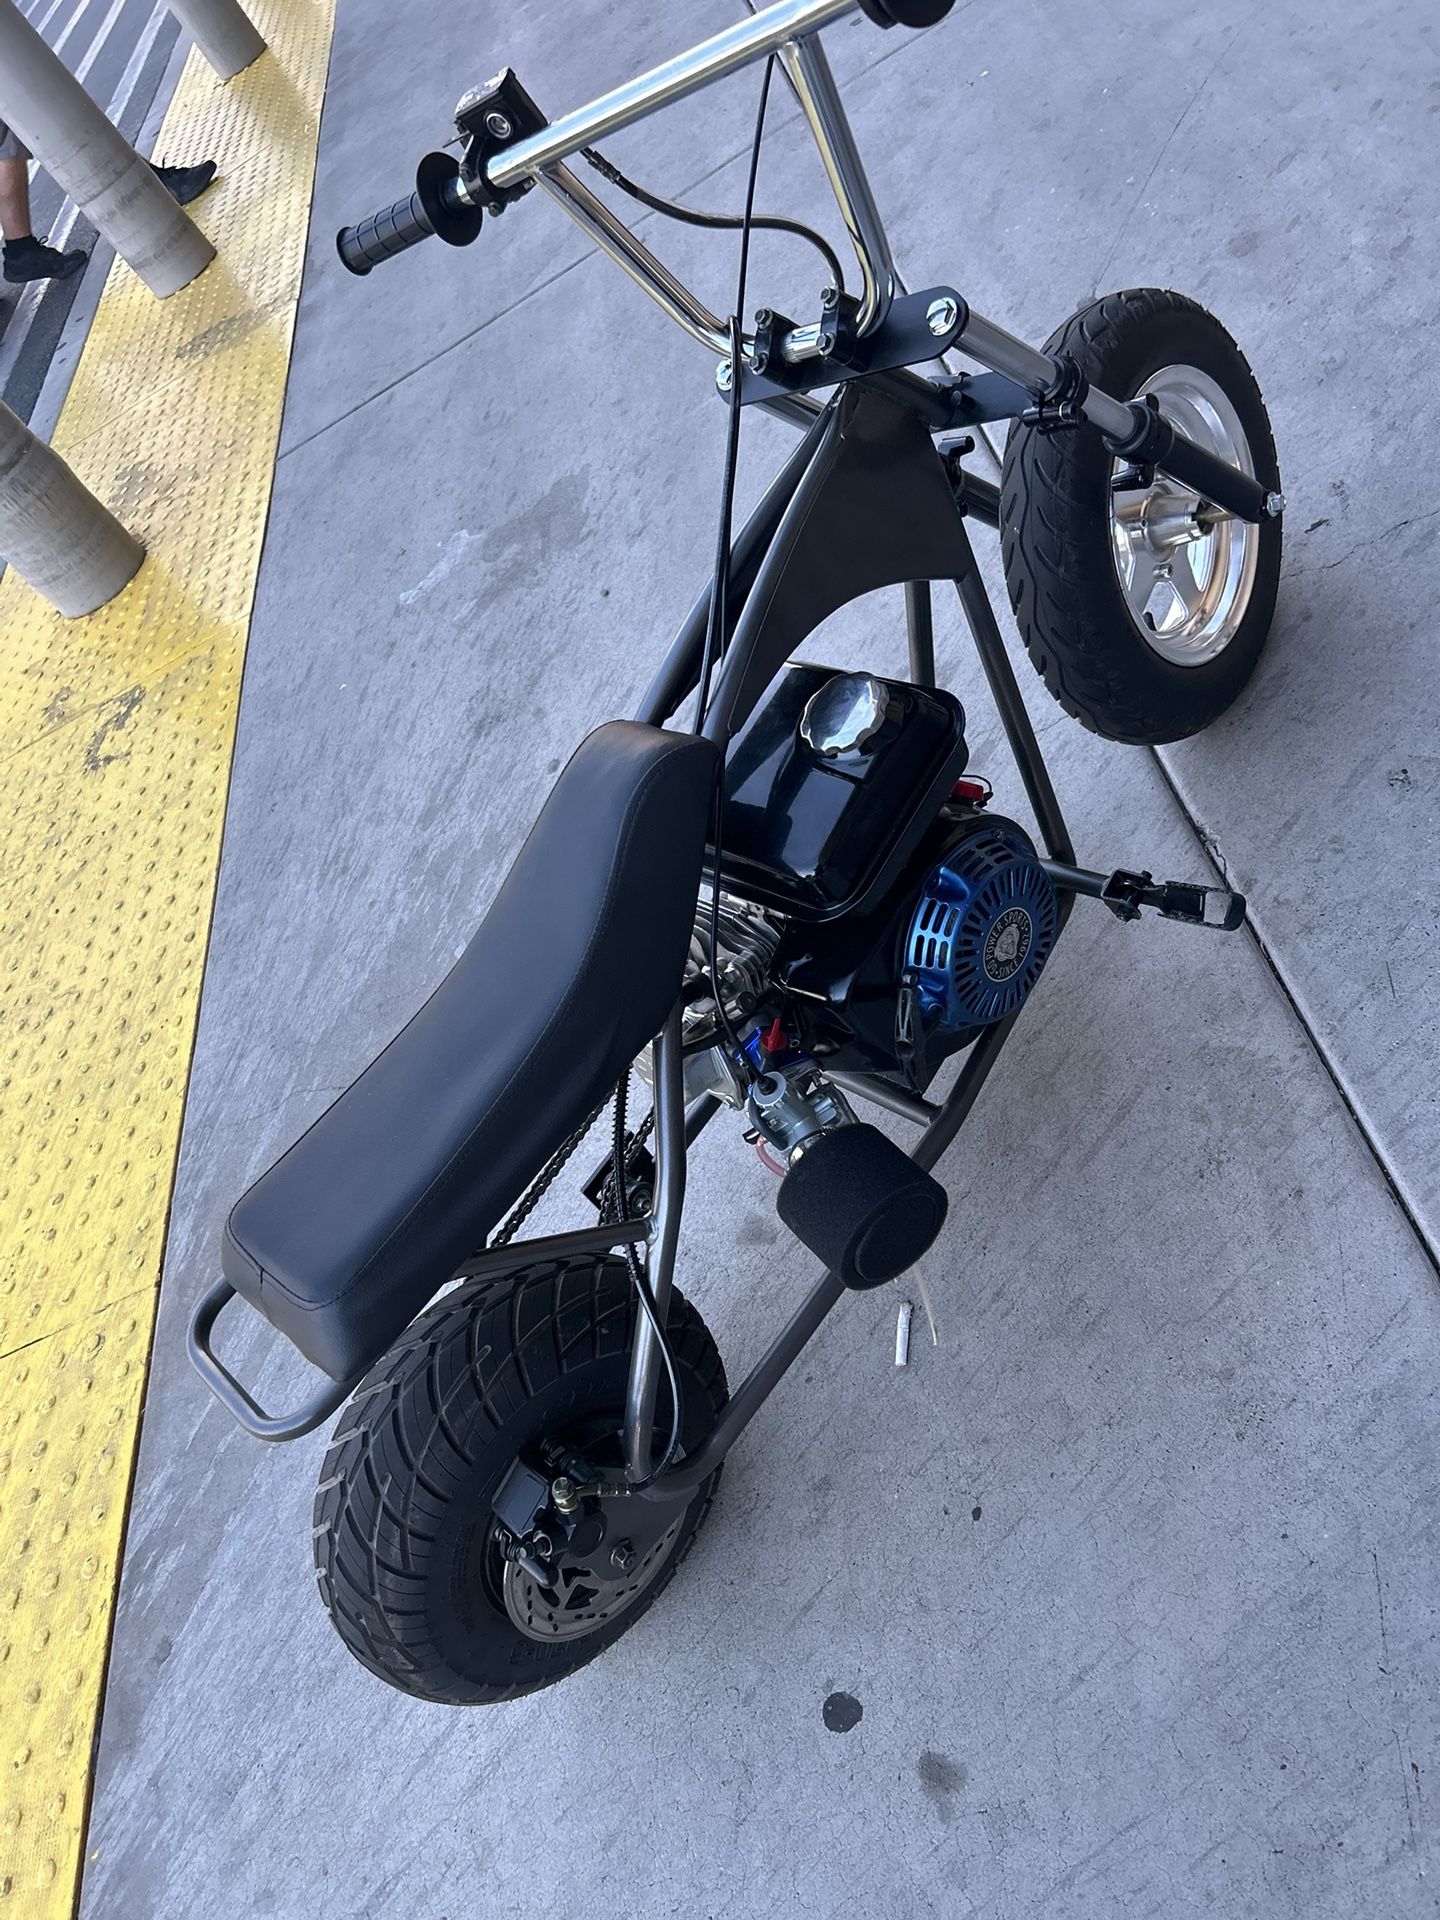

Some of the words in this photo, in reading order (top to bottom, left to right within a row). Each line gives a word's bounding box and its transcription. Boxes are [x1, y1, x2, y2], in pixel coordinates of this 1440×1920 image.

[1003, 911, 1029, 931] SPORTS
[985, 921, 1004, 961] POWER
[998, 959, 1019, 978] SINCE
[1018, 933, 1030, 958] 1962
[986, 960, 998, 975] GO
